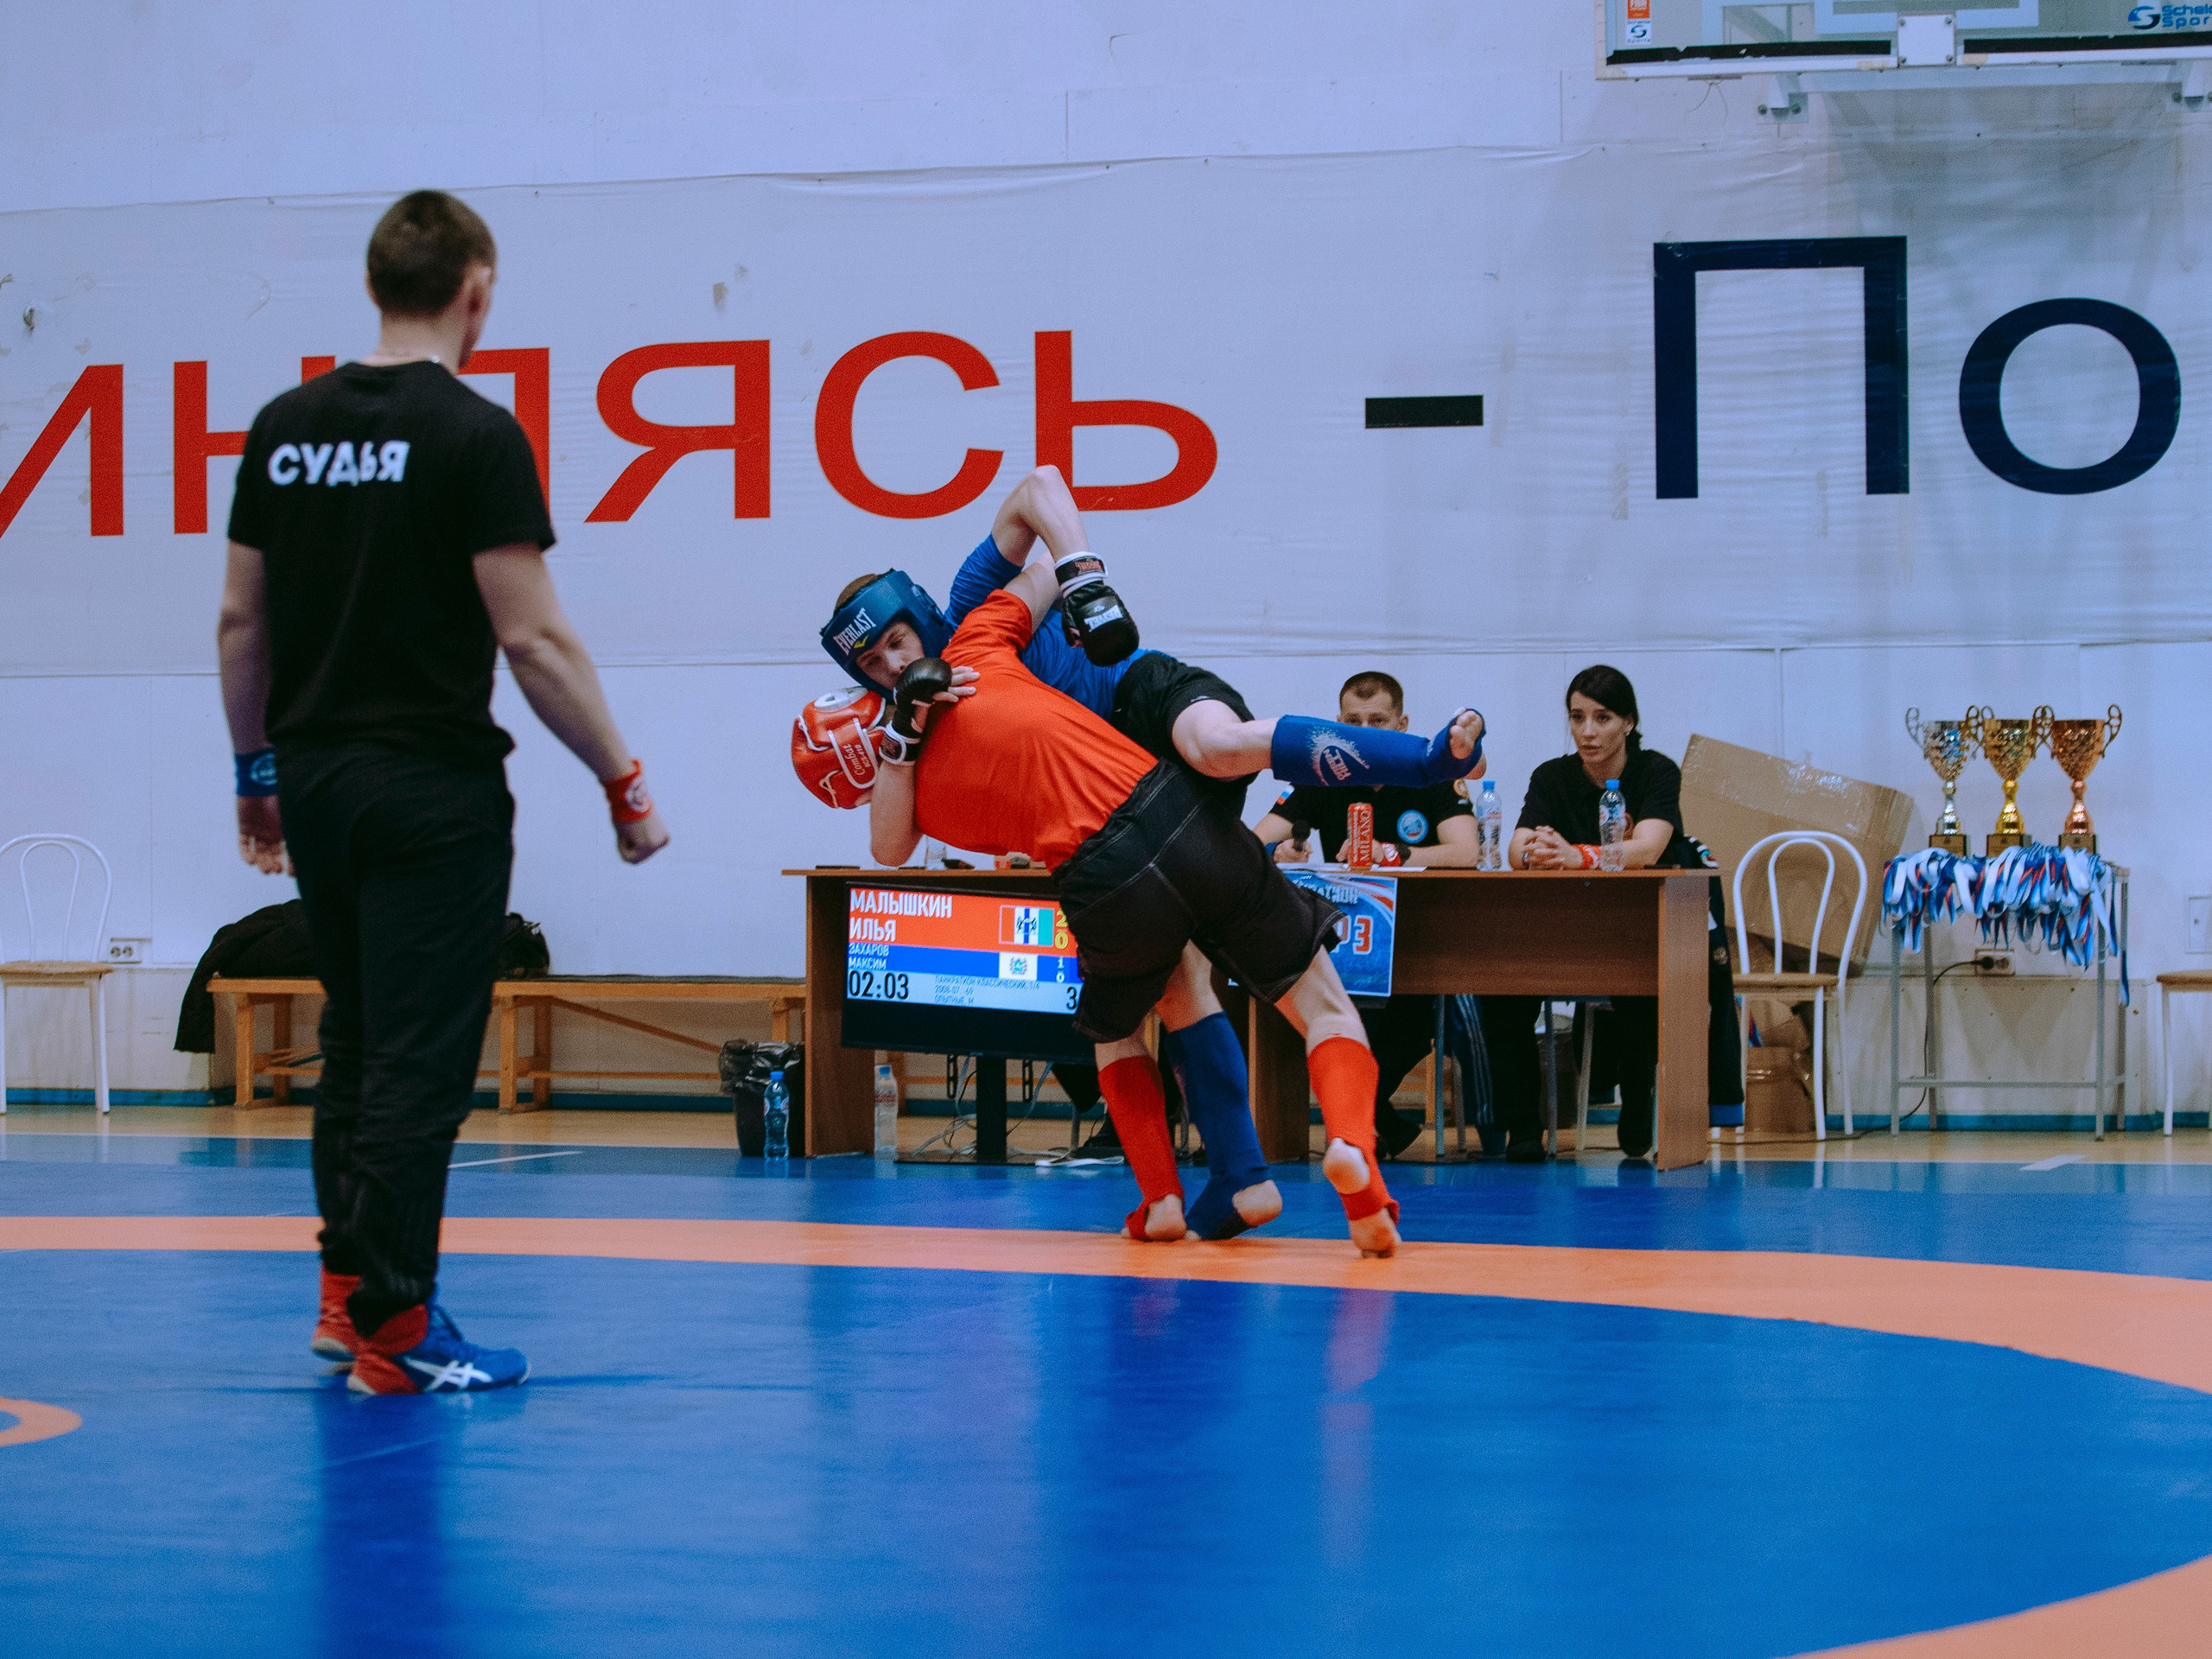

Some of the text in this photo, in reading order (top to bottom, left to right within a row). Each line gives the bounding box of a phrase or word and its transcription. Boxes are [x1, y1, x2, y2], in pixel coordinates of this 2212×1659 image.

[2161, 3, 2212, 16] Schel
[1654, 235, 2182, 499] По
[267, 439, 411, 487] СУДЬЯ
[832, 607, 877, 656] EVERLAST
[842, 743, 866, 776] Combat
[1359, 810, 1371, 862] MILANO
[849, 888, 953, 918] МАЛЫШКИН
[849, 917, 897, 943] ИЛЬЯ
[848, 942, 890, 957] ЗАХАРОВ
[848, 956, 887, 970] МАКСИМ
[849, 969, 909, 1001] 02:03
[1065, 986, 1077, 1011] 3
